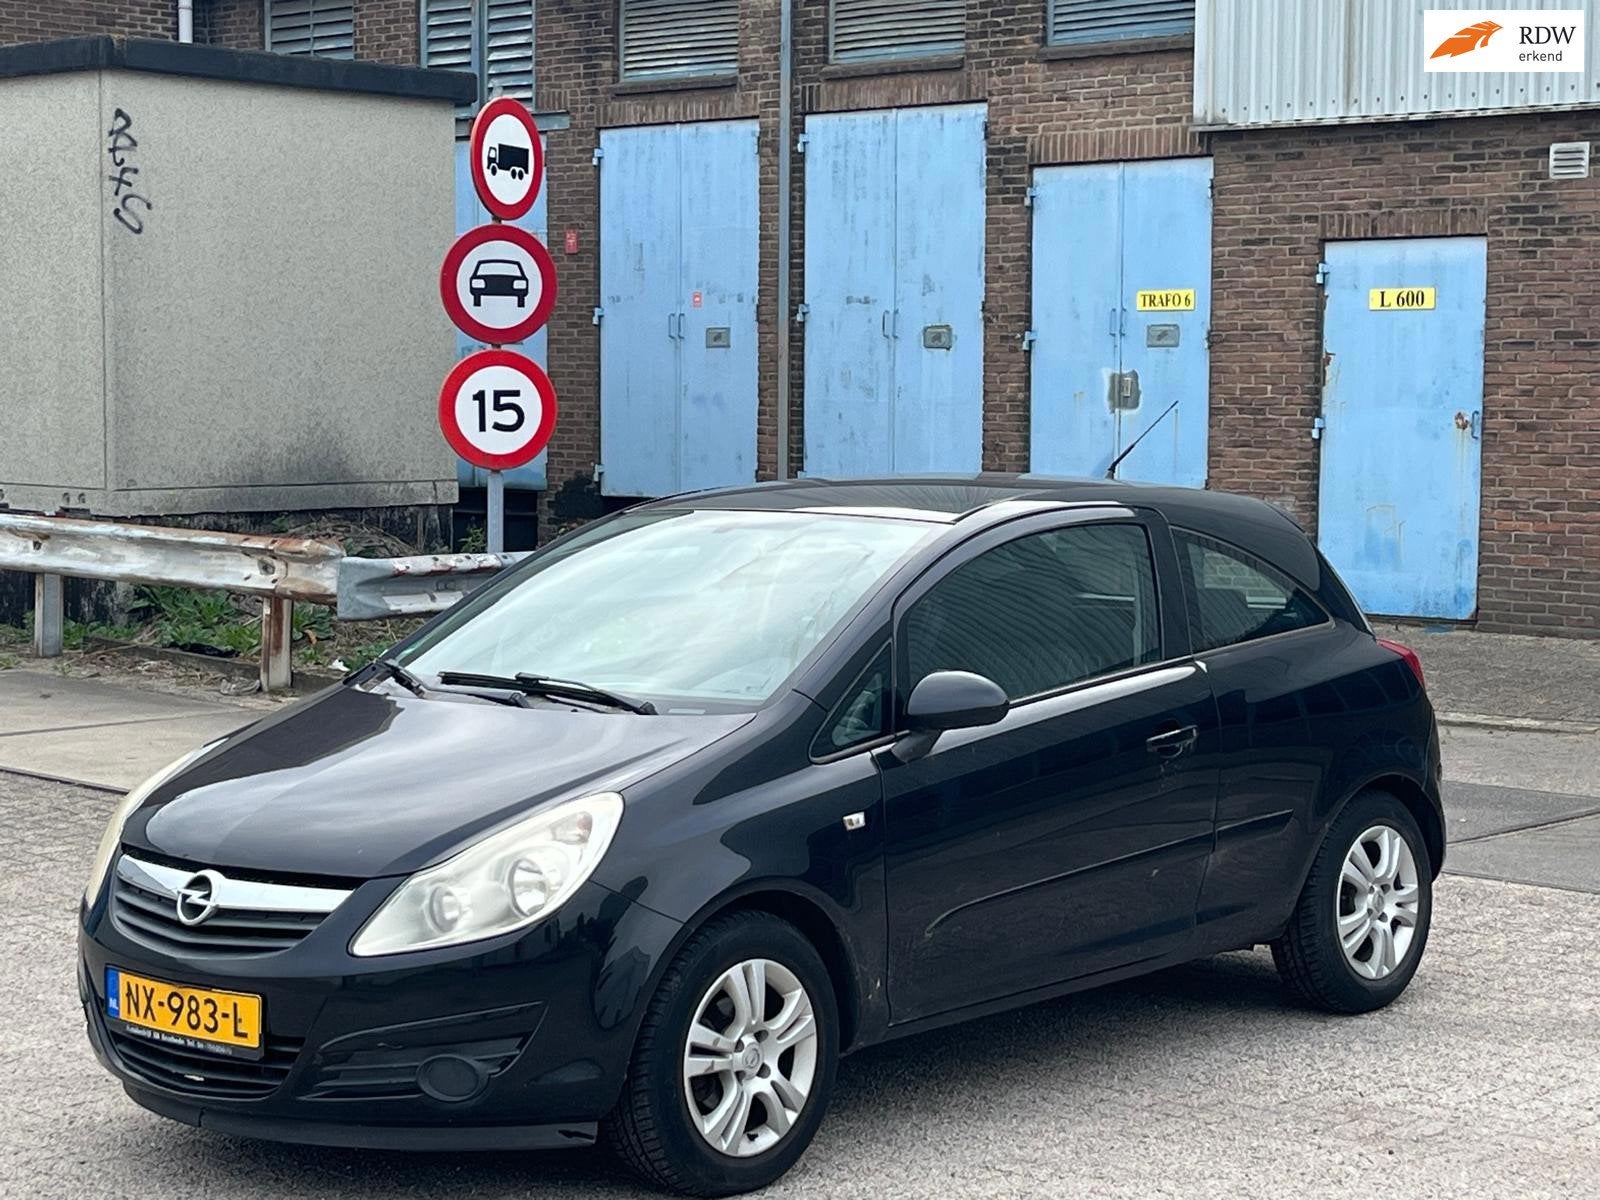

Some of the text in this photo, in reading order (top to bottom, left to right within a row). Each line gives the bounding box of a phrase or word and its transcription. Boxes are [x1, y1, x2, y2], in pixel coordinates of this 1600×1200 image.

[1140, 293, 1192, 308] TRAFO 6
[1380, 289, 1425, 308] L 600
[472, 389, 525, 433] 15
[125, 981, 249, 1039] NX-983-L
